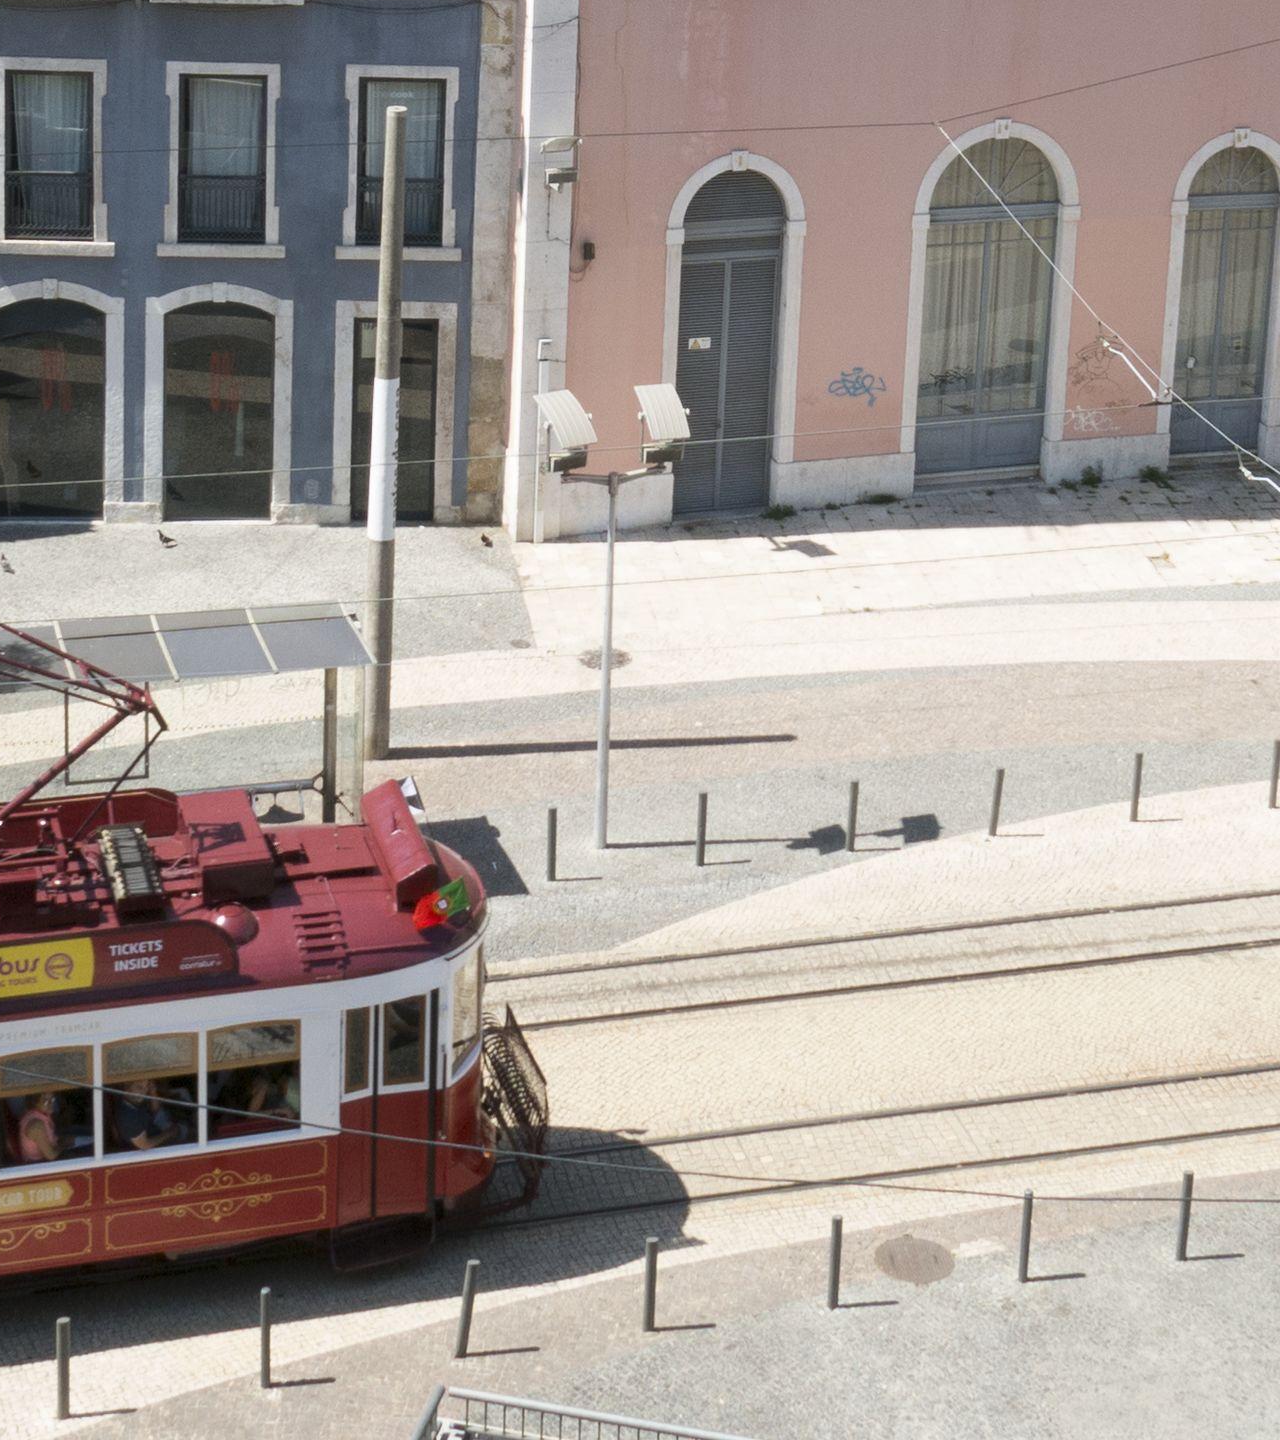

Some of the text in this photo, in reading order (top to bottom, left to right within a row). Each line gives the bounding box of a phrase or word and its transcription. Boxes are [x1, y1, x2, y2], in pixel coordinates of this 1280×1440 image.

[107, 939, 164, 957] TICKETS
[114, 956, 159, 972] INSIDE
[8, 976, 38, 987] TOURS
[29, 1186, 64, 1203] TOUR
